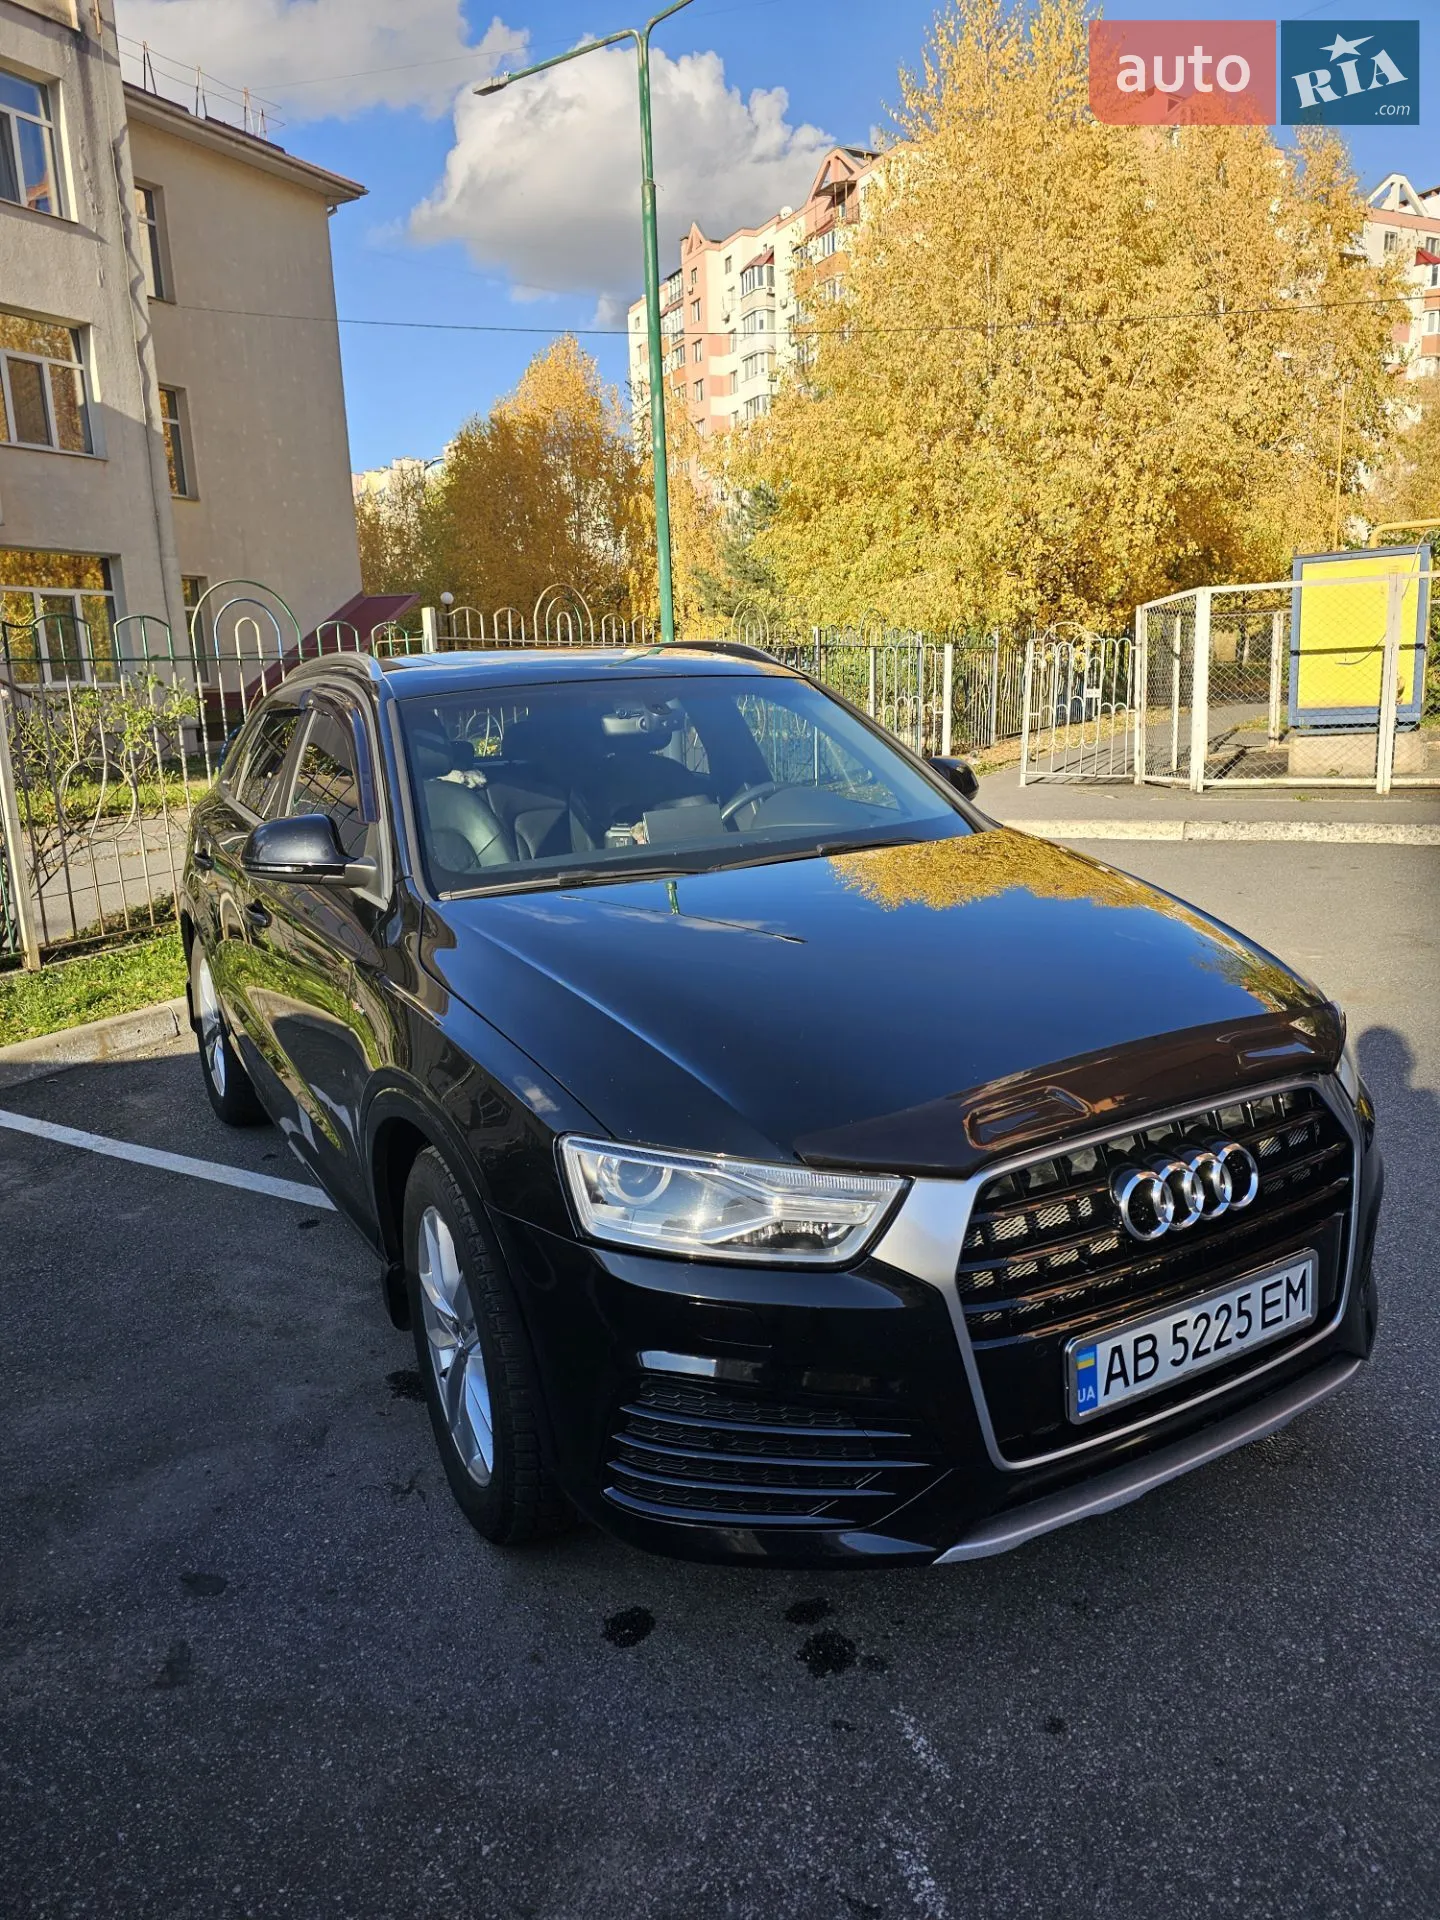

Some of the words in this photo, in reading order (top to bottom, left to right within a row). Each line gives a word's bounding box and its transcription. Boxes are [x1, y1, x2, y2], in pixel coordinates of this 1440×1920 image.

[1103, 1333, 1159, 1397] AB
[1170, 1292, 1251, 1367] 5225
[1261, 1268, 1307, 1330] EM
[1077, 1385, 1096, 1403] UA
